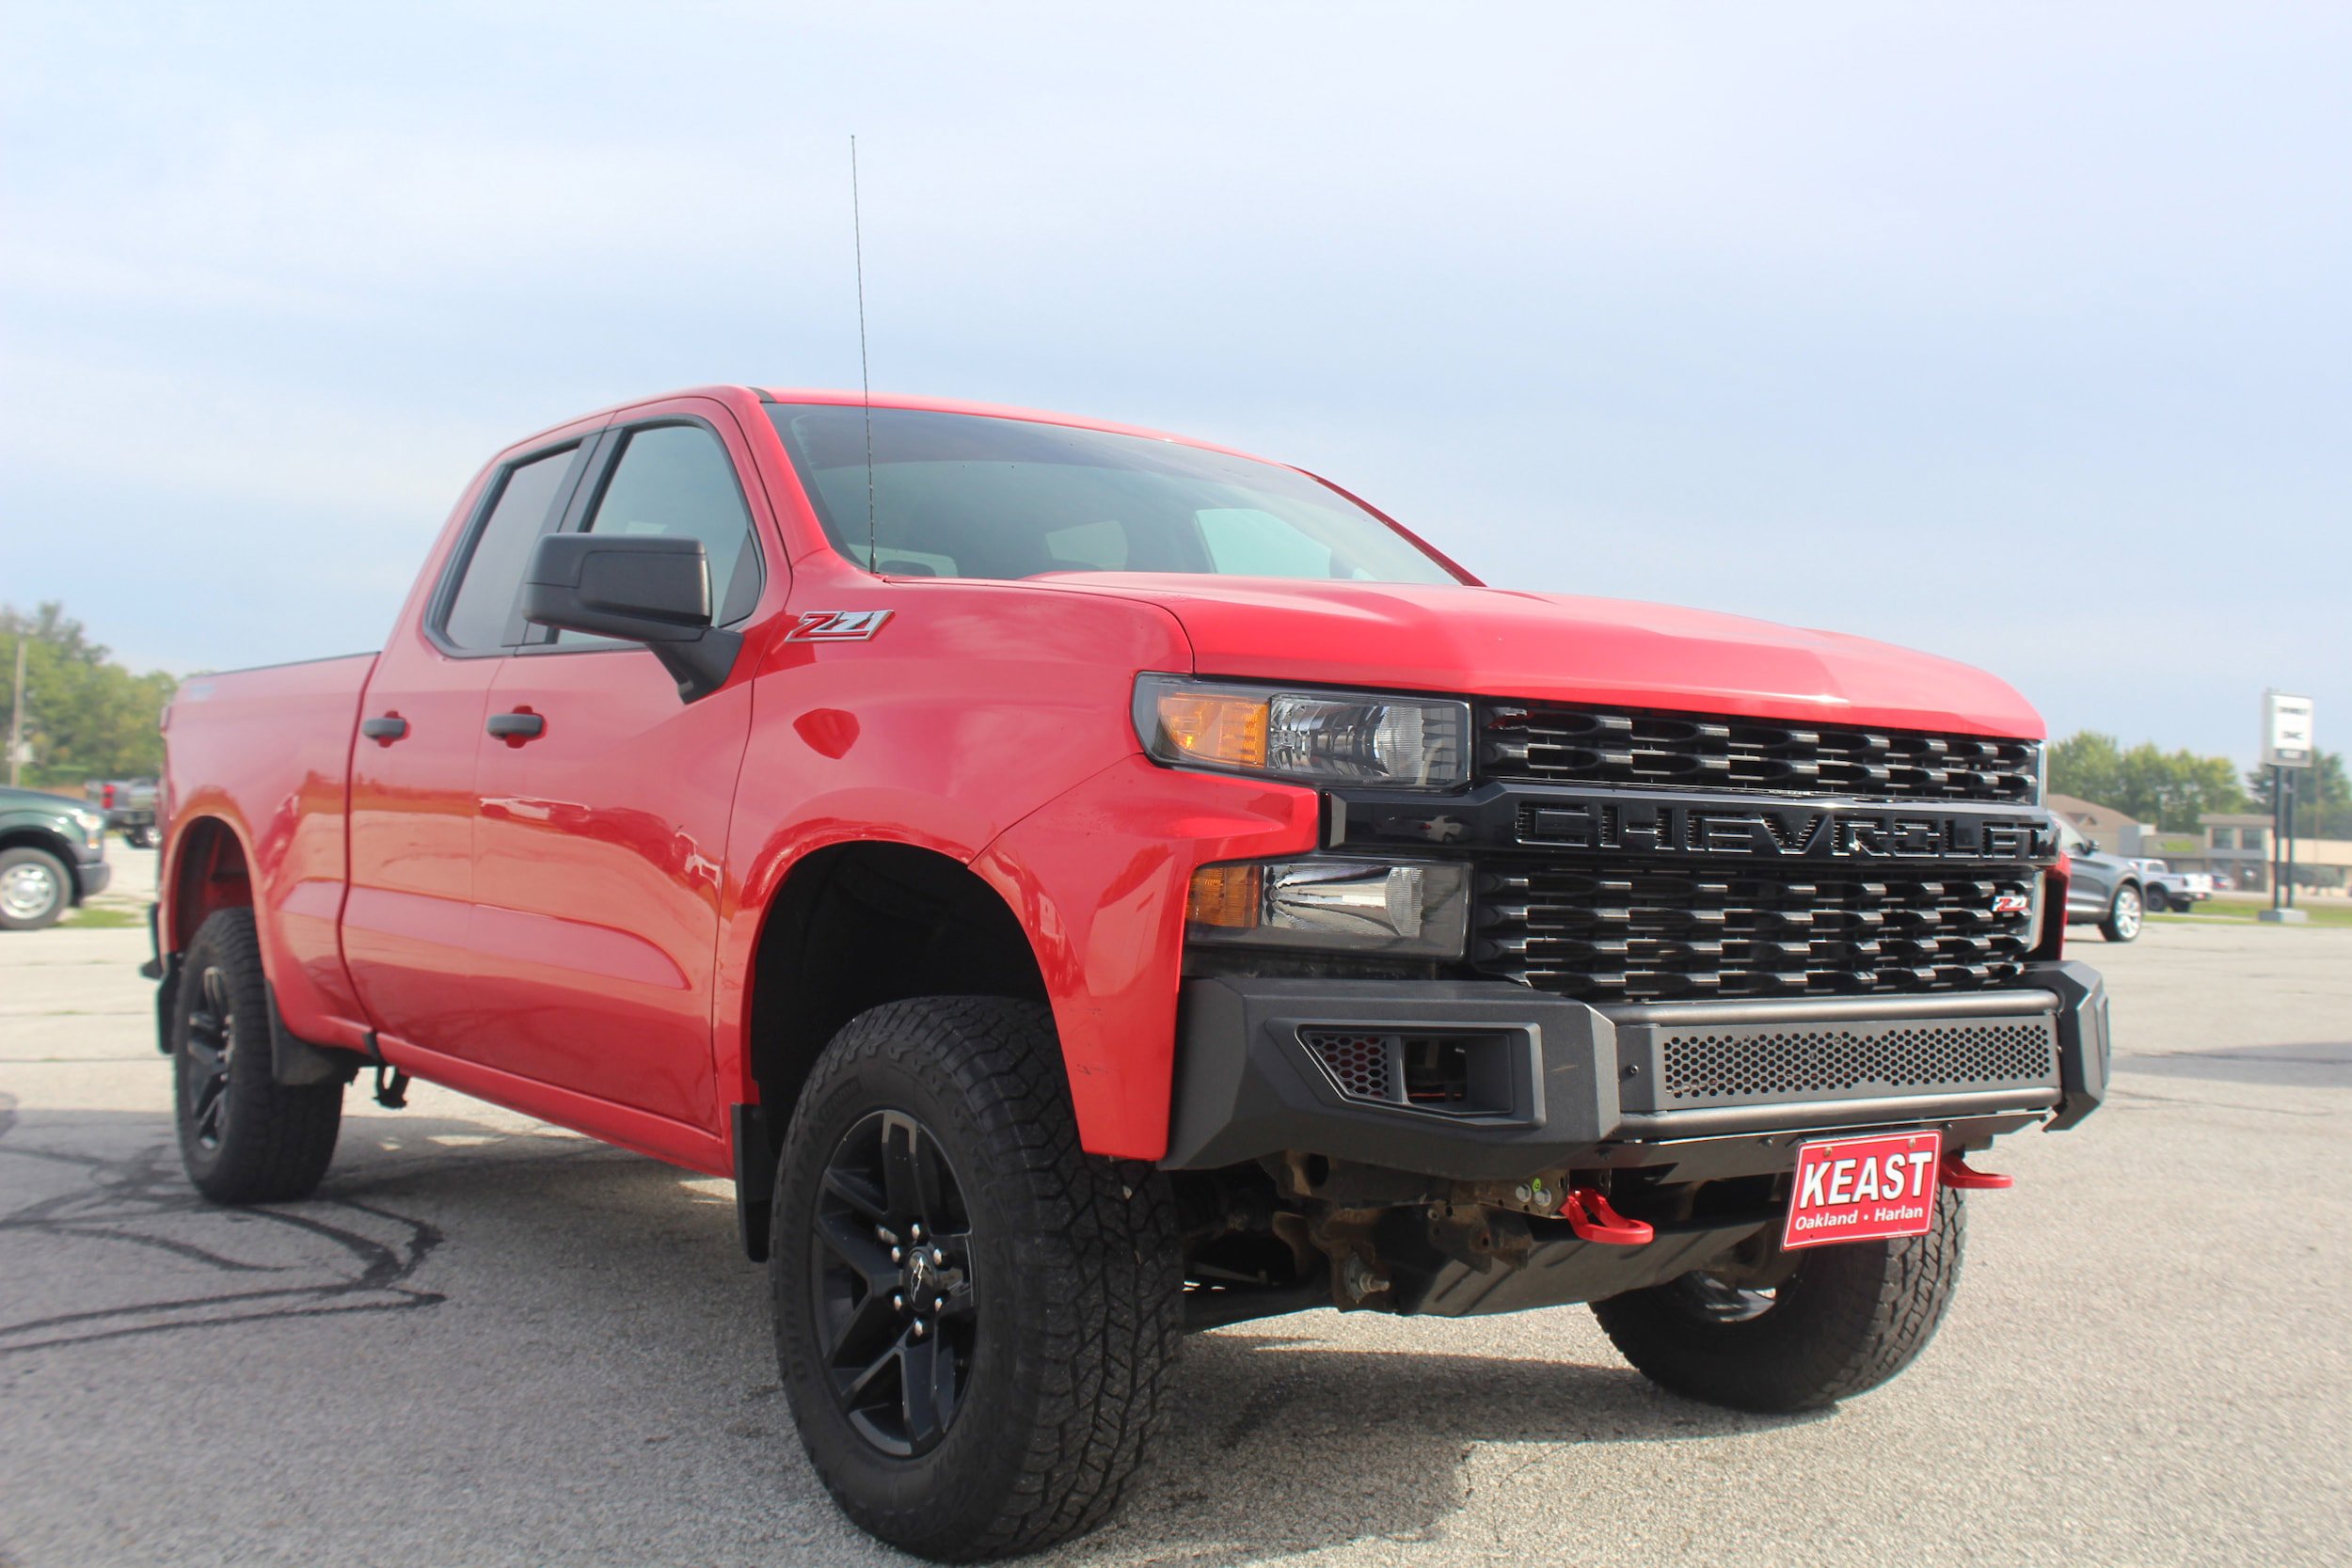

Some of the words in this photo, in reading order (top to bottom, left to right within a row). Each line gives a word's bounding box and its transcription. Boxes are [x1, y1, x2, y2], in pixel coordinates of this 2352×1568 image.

[785, 610, 895, 641] Z71
[1516, 801, 2049, 859] CHEVROLET
[1800, 1151, 1932, 1209] KEAST
[1795, 1209, 1858, 1230] Oakland
[1874, 1205, 1923, 1222] Harlan
